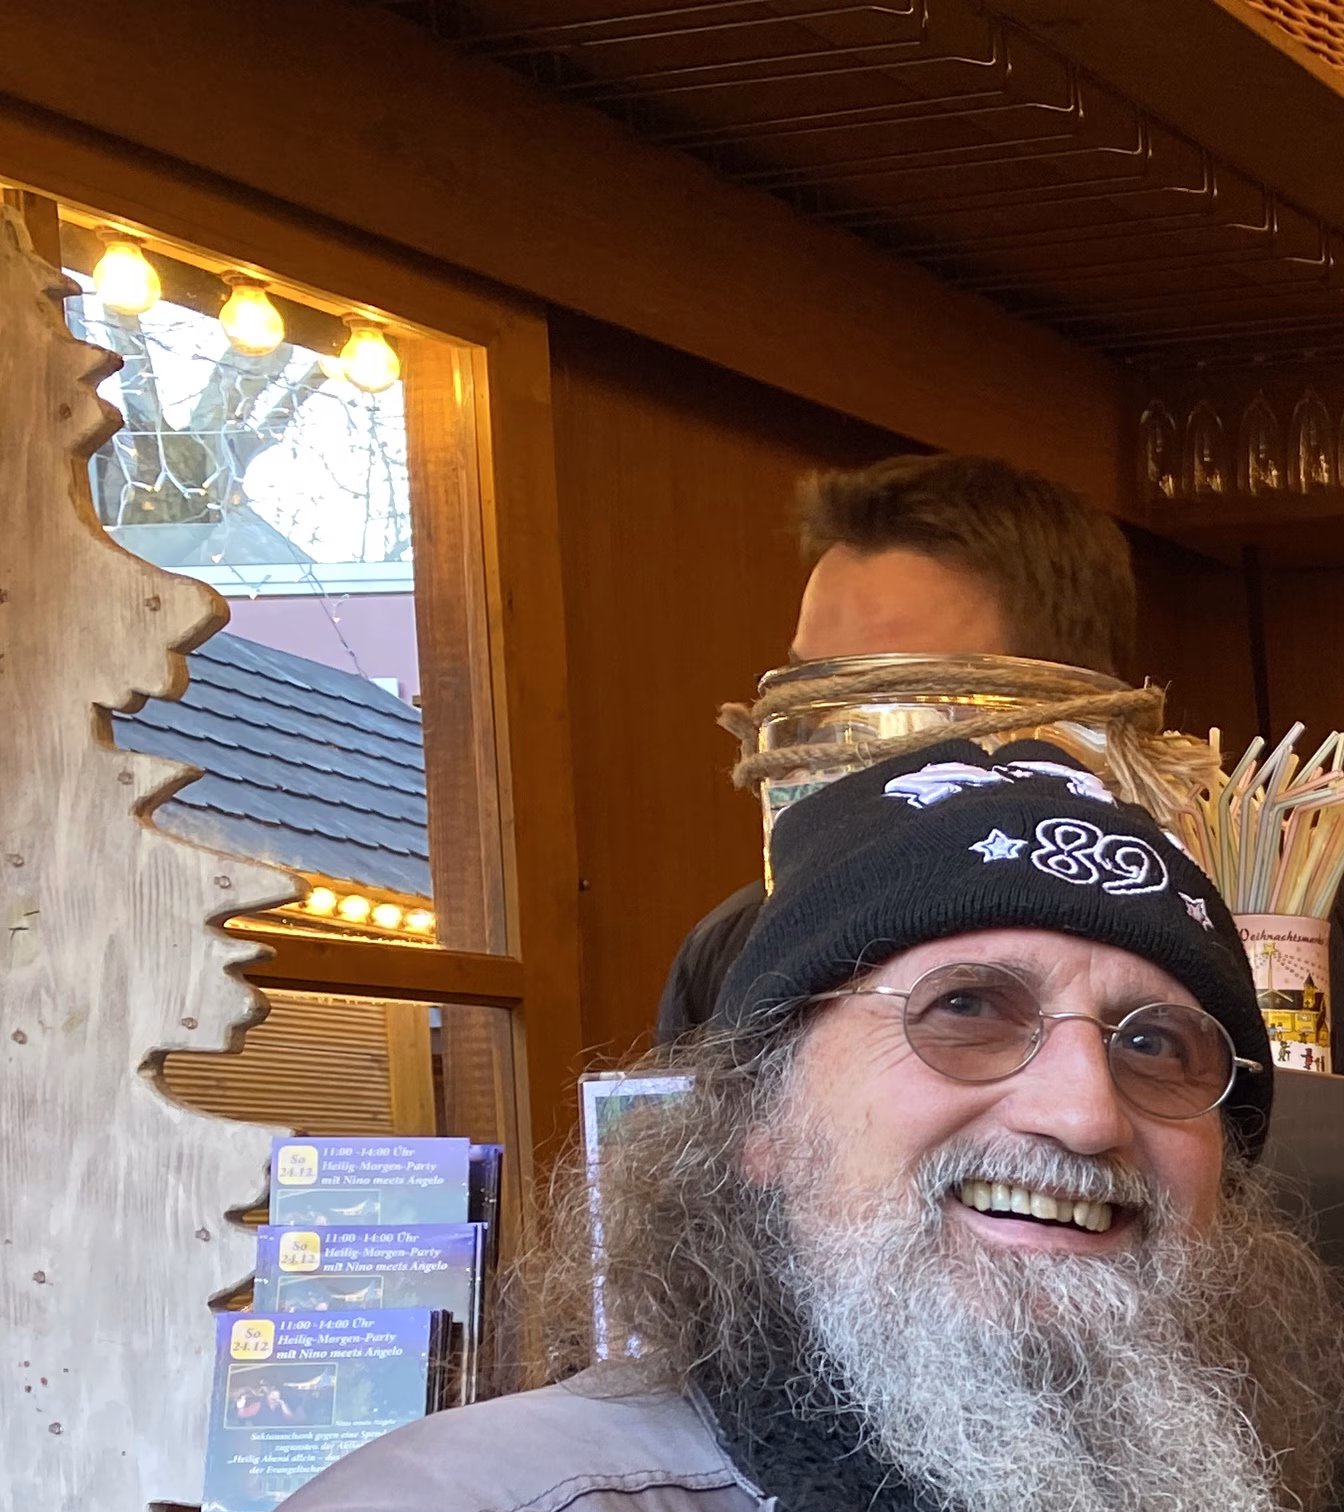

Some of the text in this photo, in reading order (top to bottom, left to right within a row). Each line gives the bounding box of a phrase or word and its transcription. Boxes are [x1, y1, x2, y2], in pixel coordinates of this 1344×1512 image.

[1031, 817, 1169, 895] 89
[298, 1348, 328, 1359] Nino
[330, 1348, 363, 1358] meets
[364, 1346, 403, 1360] Angelo
